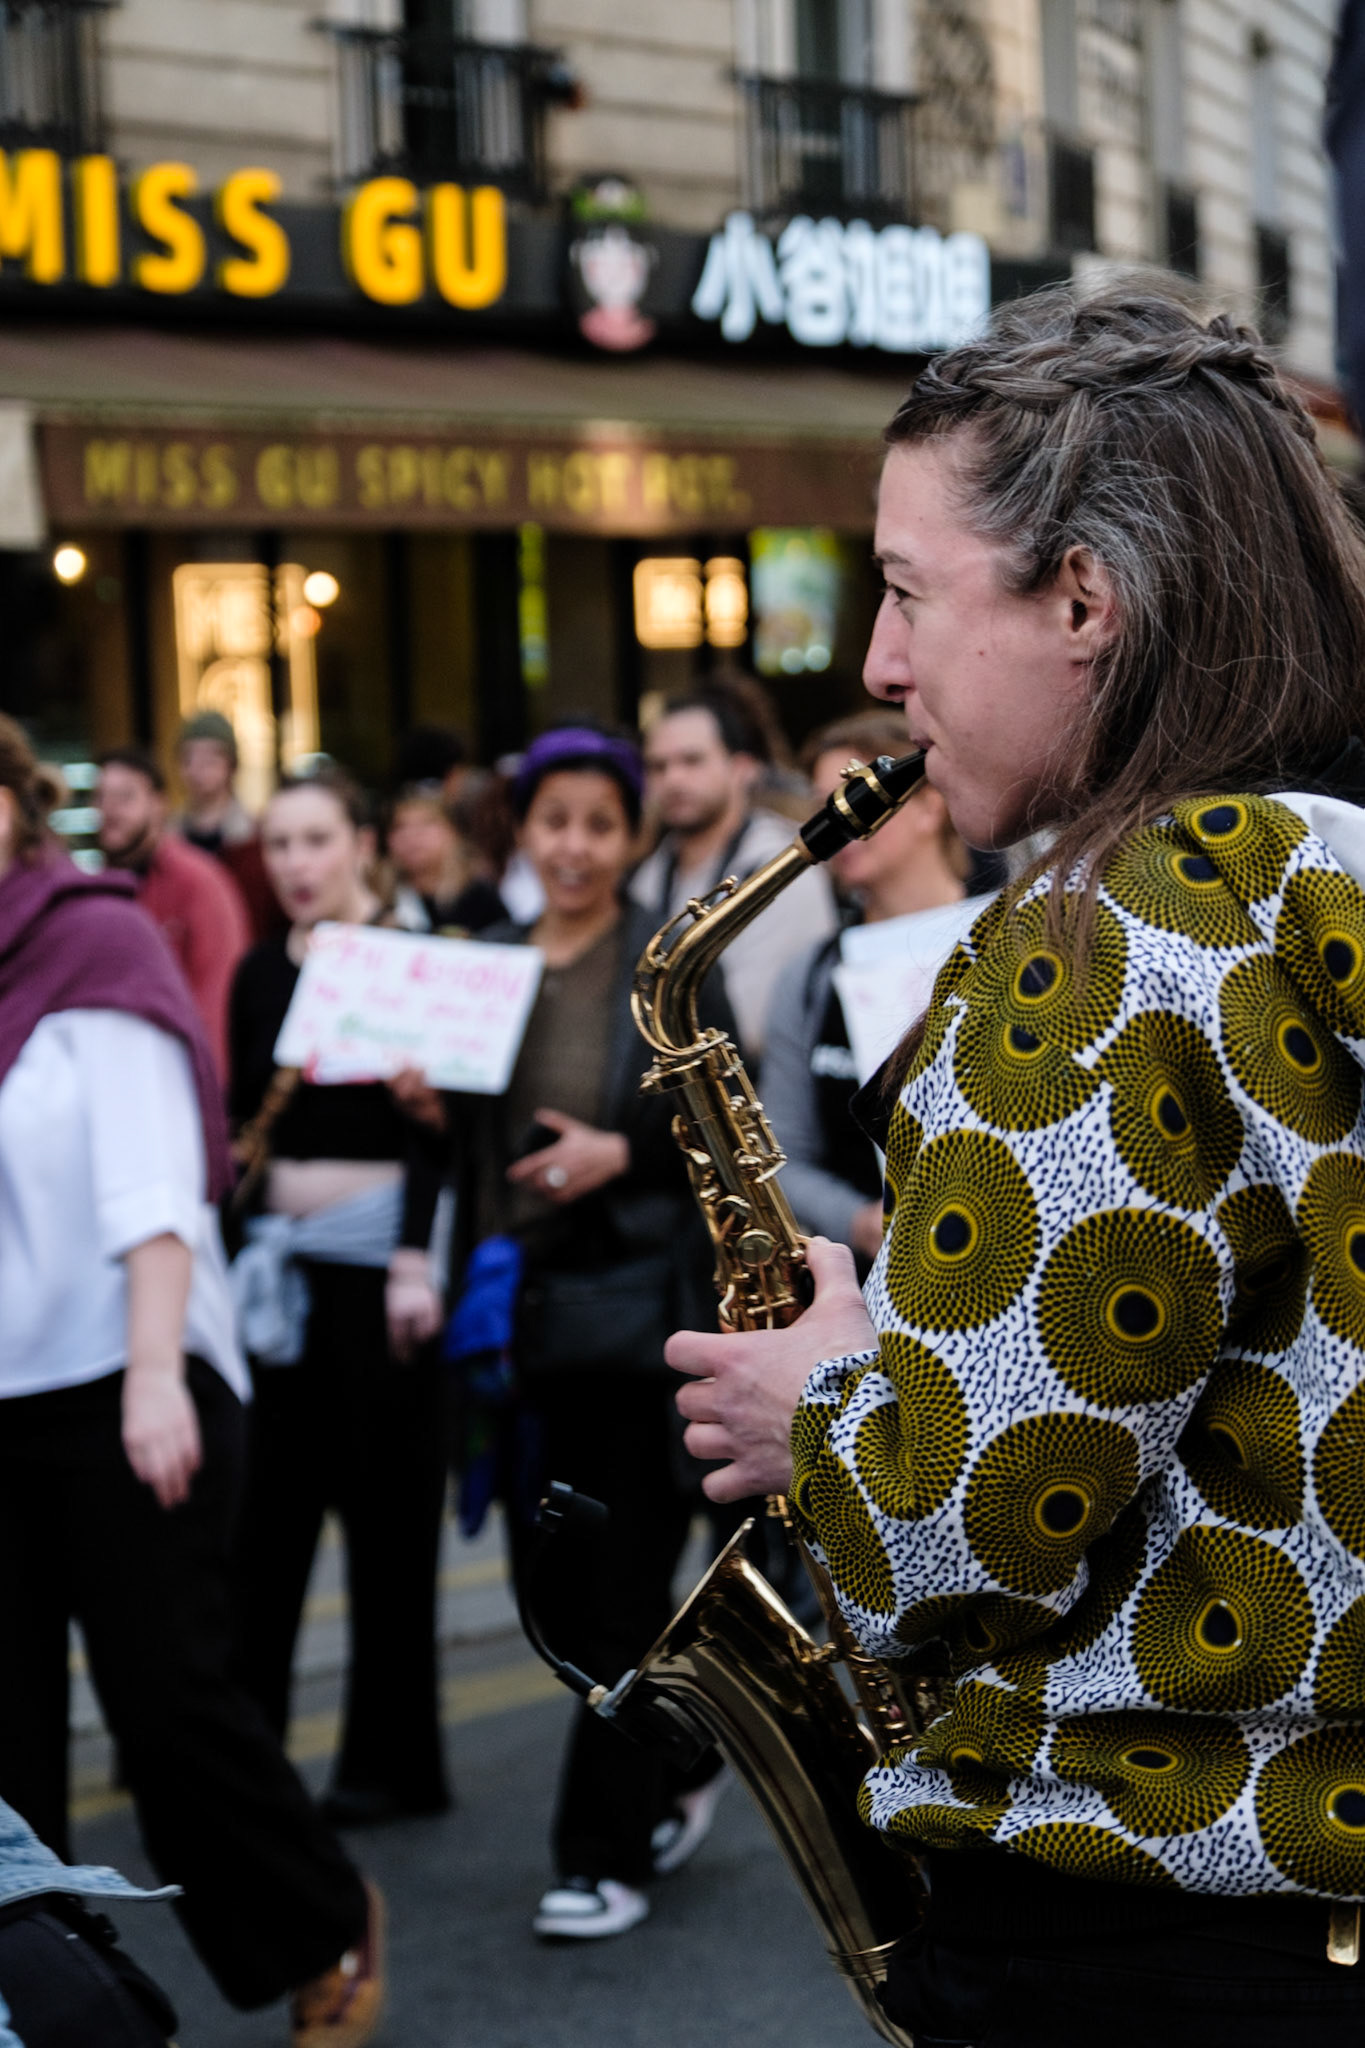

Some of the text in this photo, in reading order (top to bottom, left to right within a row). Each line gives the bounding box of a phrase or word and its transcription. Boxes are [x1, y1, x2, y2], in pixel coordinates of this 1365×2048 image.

[0, 147, 506, 310] MISS GU
[84, 439, 238, 511] MISS
[256, 444, 340, 512] GU
[356, 445, 510, 513] SPICY
